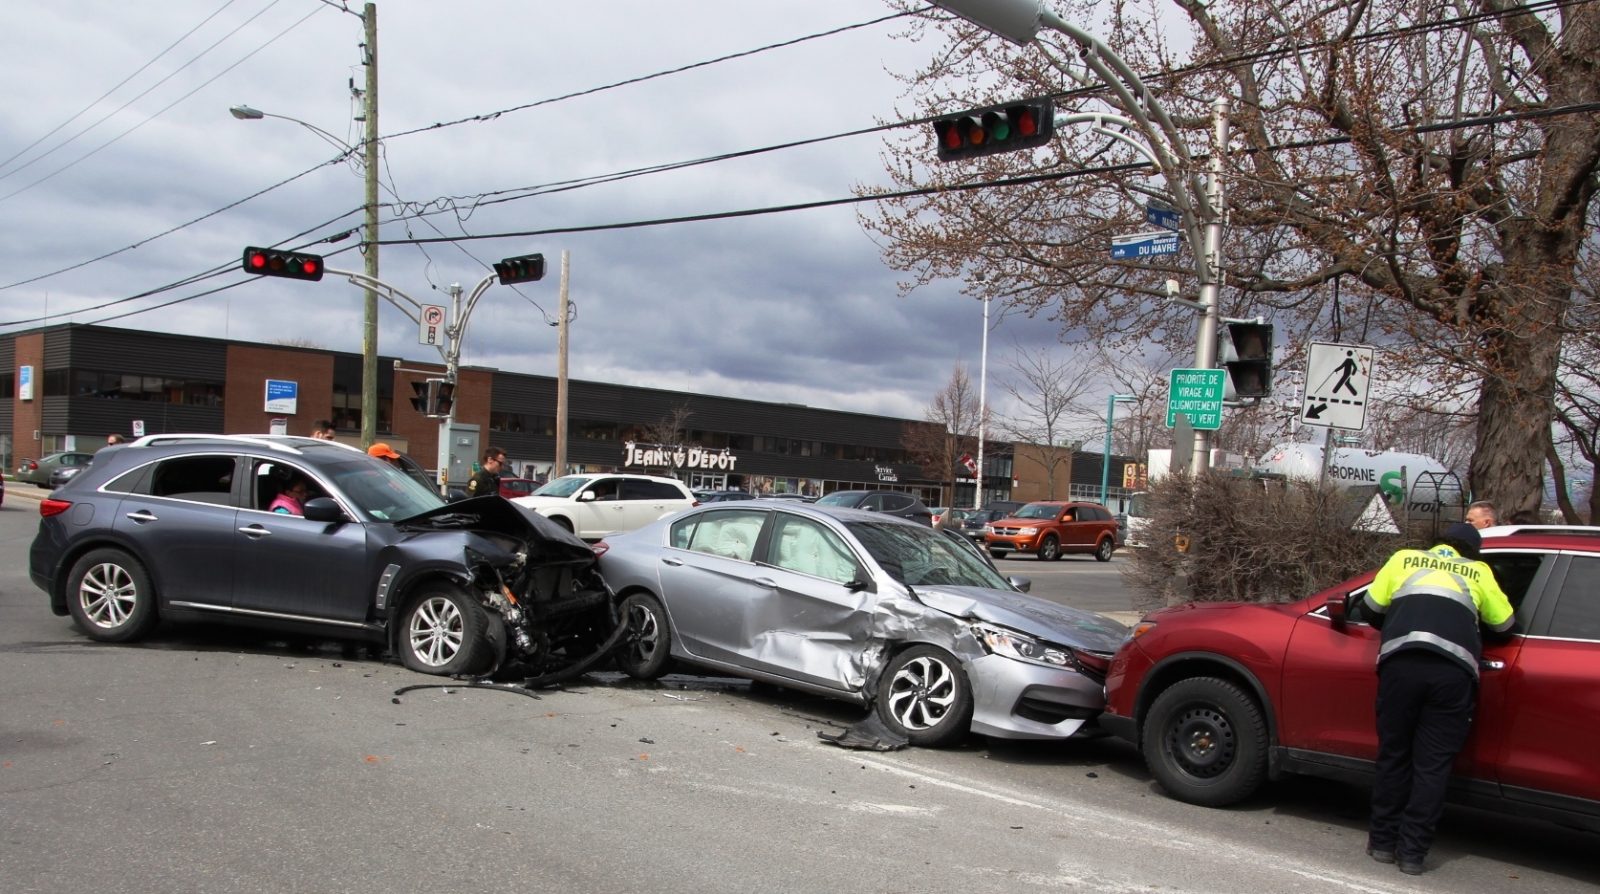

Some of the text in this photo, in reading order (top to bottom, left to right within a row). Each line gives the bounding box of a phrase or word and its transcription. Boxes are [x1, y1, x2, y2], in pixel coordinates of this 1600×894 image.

[1138, 243, 1177, 255] DU HAVRE
[1176, 371, 1218, 385] PRIORITÉ DE
[1178, 387, 1214, 398] VIRAGE AU
[1169, 399, 1220, 411] CLIGNOTEMENT
[1198, 413, 1216, 424] VERT
[878, 472, 898, 482] Canada
[1403, 556, 1481, 583] PARAMEDIC
